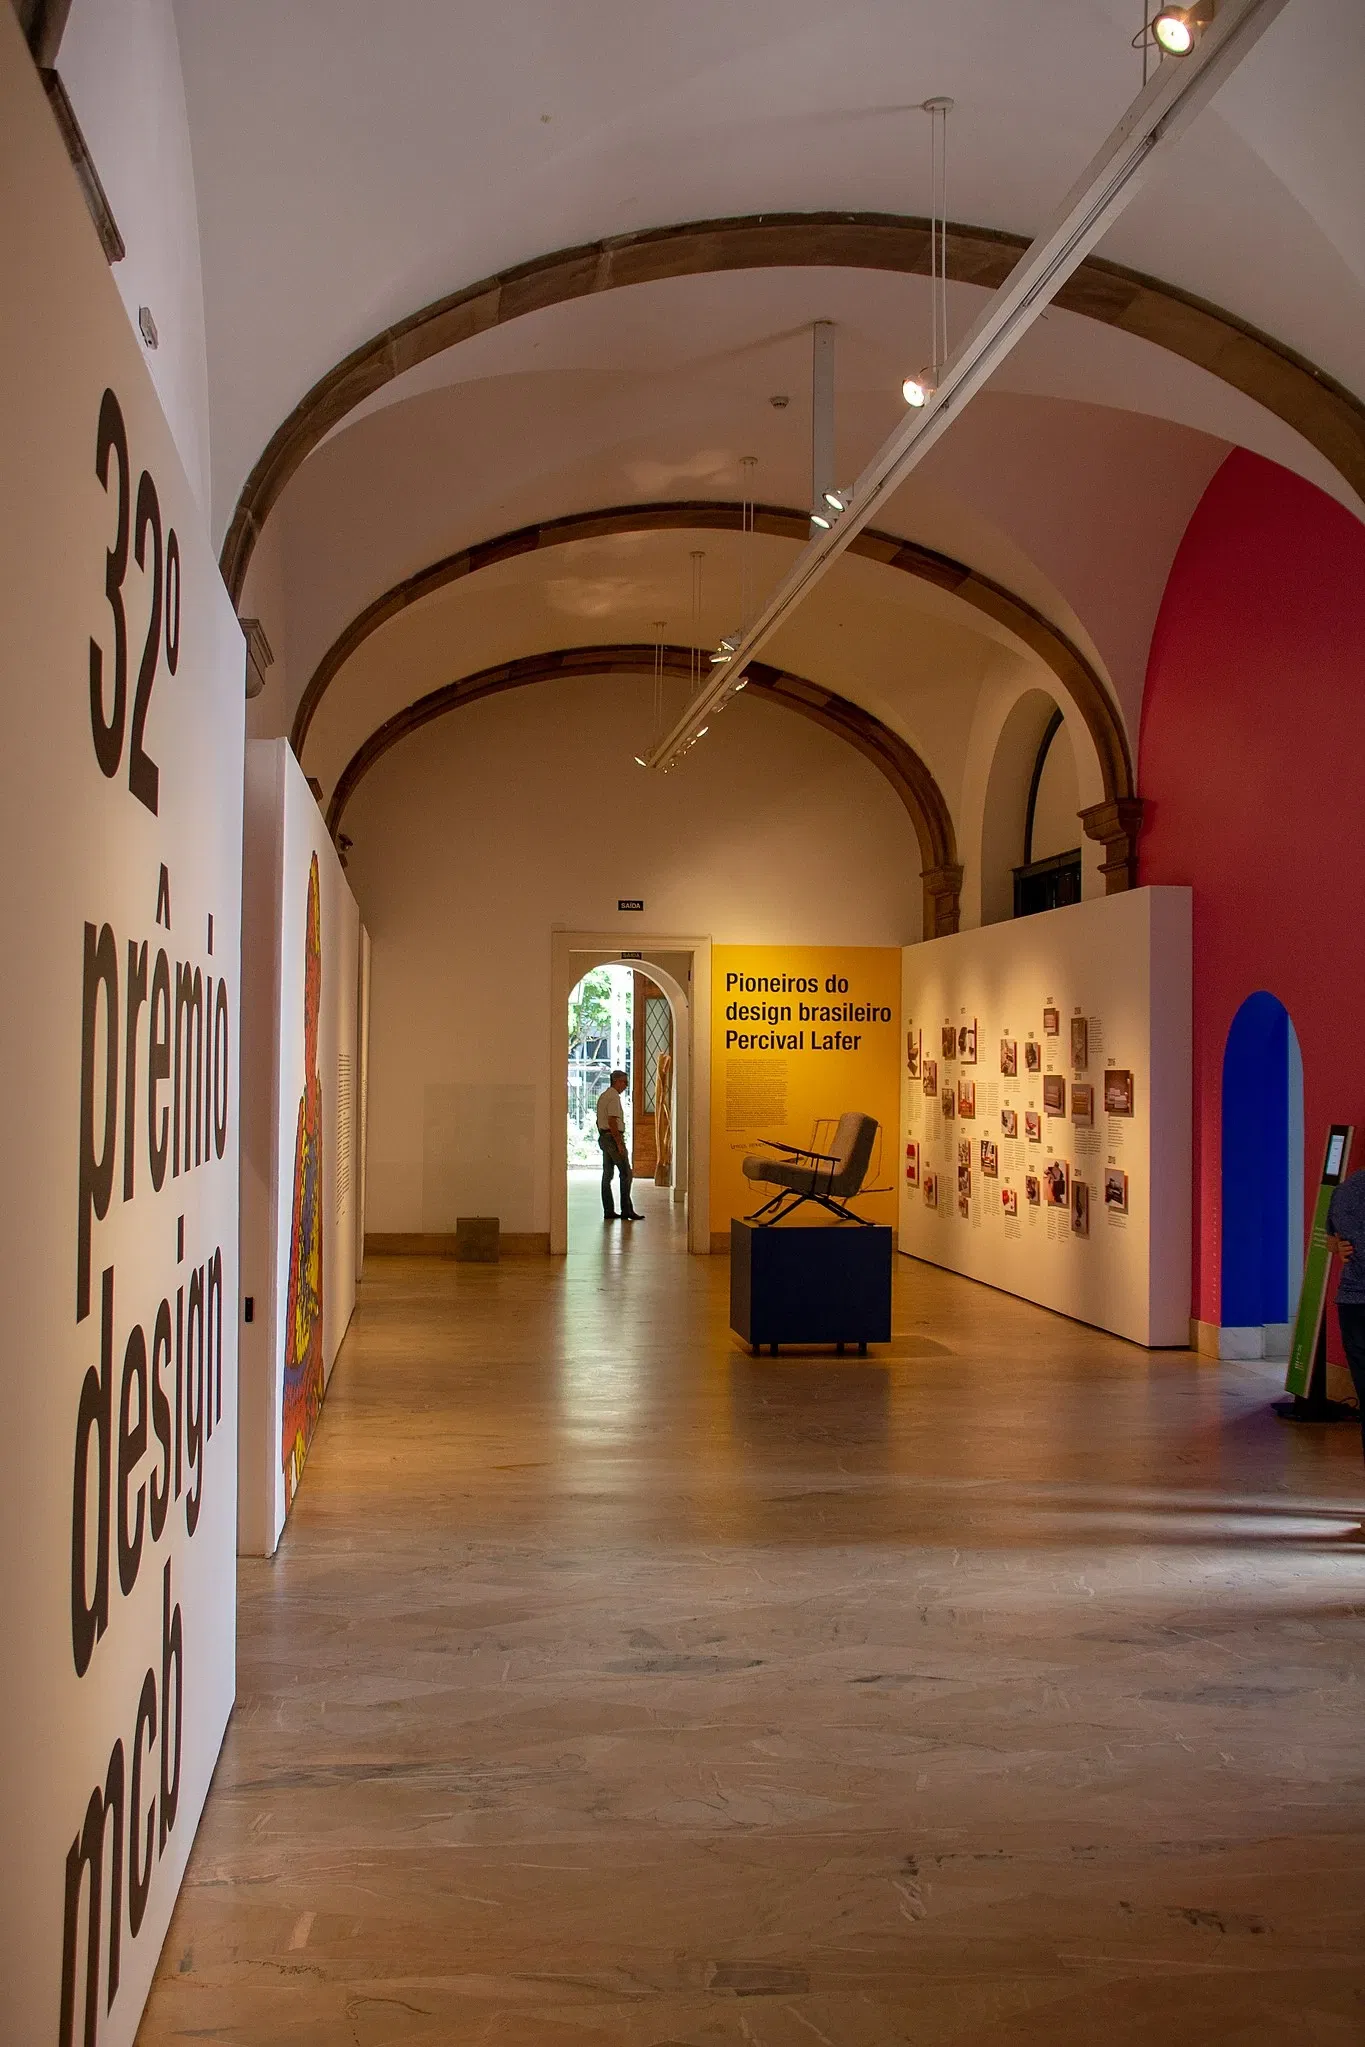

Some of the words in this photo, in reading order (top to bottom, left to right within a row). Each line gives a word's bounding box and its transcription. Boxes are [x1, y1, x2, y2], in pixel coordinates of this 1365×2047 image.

[76, 862, 229, 1325] prêmio
[725, 1002, 792, 1026] design
[799, 1003, 892, 1023] brasileiro
[726, 973, 819, 993] Pioneiros
[825, 974, 849, 994] do
[726, 1030, 804, 1050] Percival
[811, 1031, 862, 1051] Lafer
[71, 1215, 222, 1678] design
[58, 1554, 183, 2047] mcb
